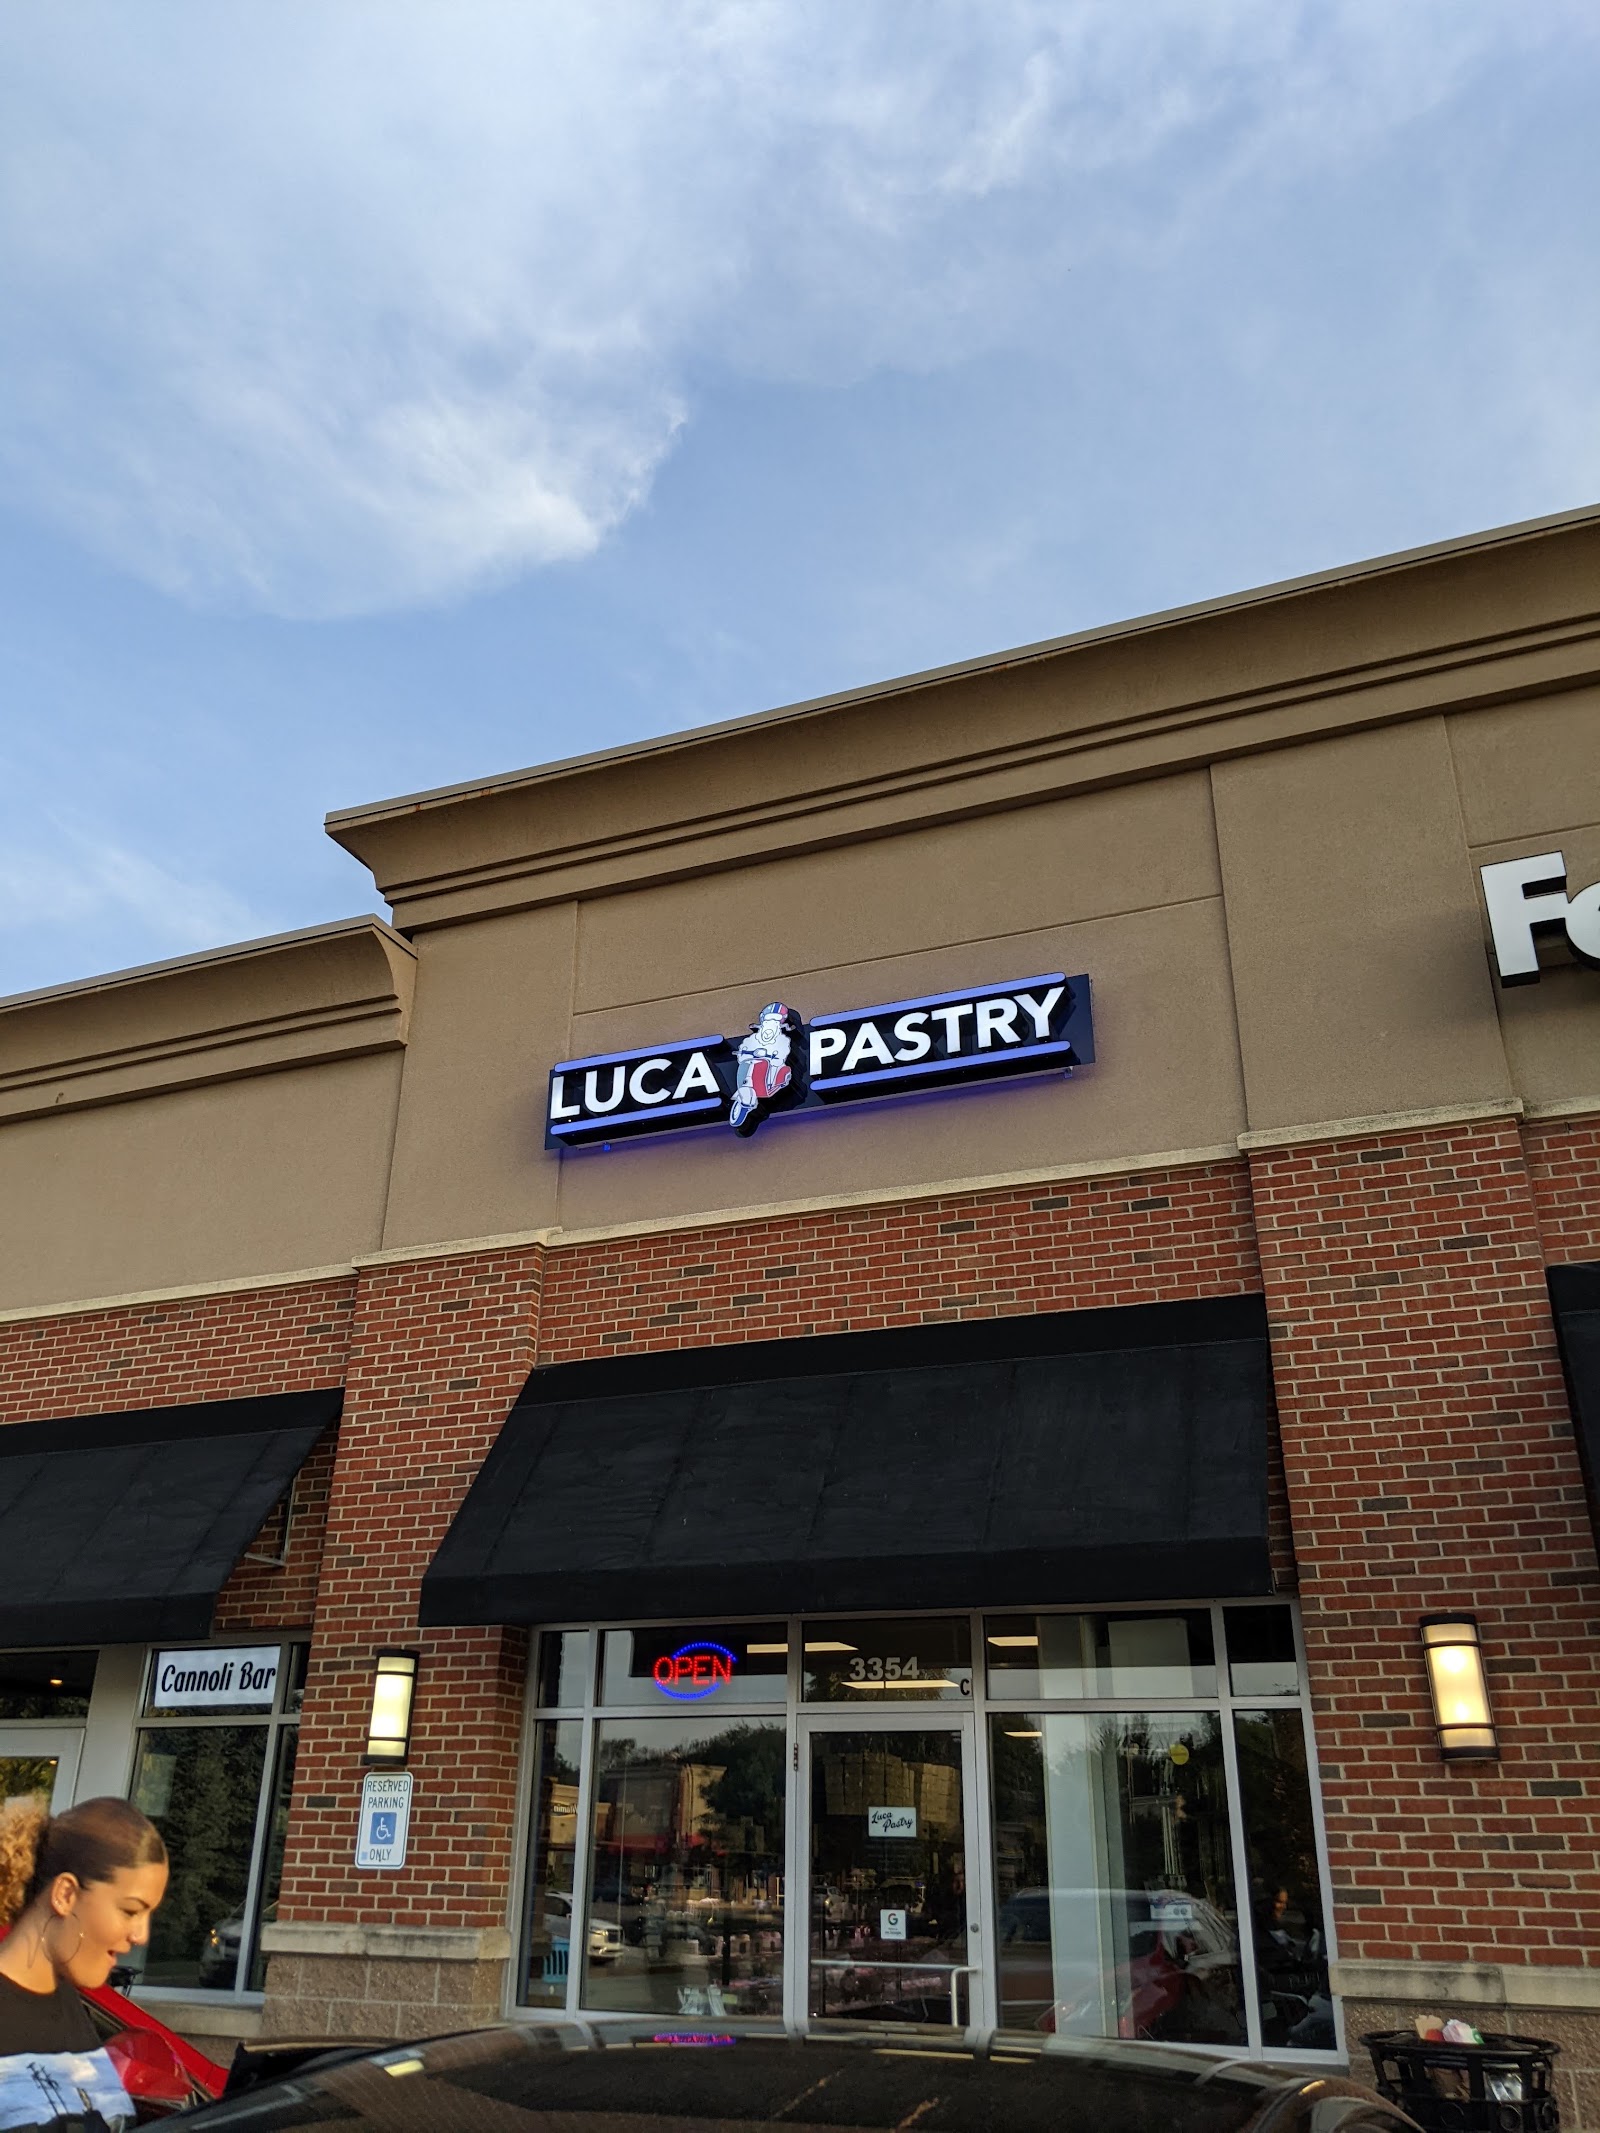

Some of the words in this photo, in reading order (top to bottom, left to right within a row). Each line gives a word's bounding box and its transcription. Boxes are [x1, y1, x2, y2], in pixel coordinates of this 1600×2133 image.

[550, 1052, 720, 1119] LUCA
[810, 986, 1065, 1076] PASTRY
[161, 1662, 234, 1692] Cannoli
[239, 1661, 276, 1690] Bar
[653, 1655, 731, 1686] OPEN
[849, 1656, 919, 1681] 3354
[960, 1678, 970, 1696] C
[367, 1780, 408, 1792] RESERVED
[368, 1796, 404, 1809] PARKING
[871, 1810, 892, 1824] Luca
[882, 1816, 913, 1832] Pastry
[369, 1848, 391, 1861] ONLY
[888, 1912, 898, 1926] G
